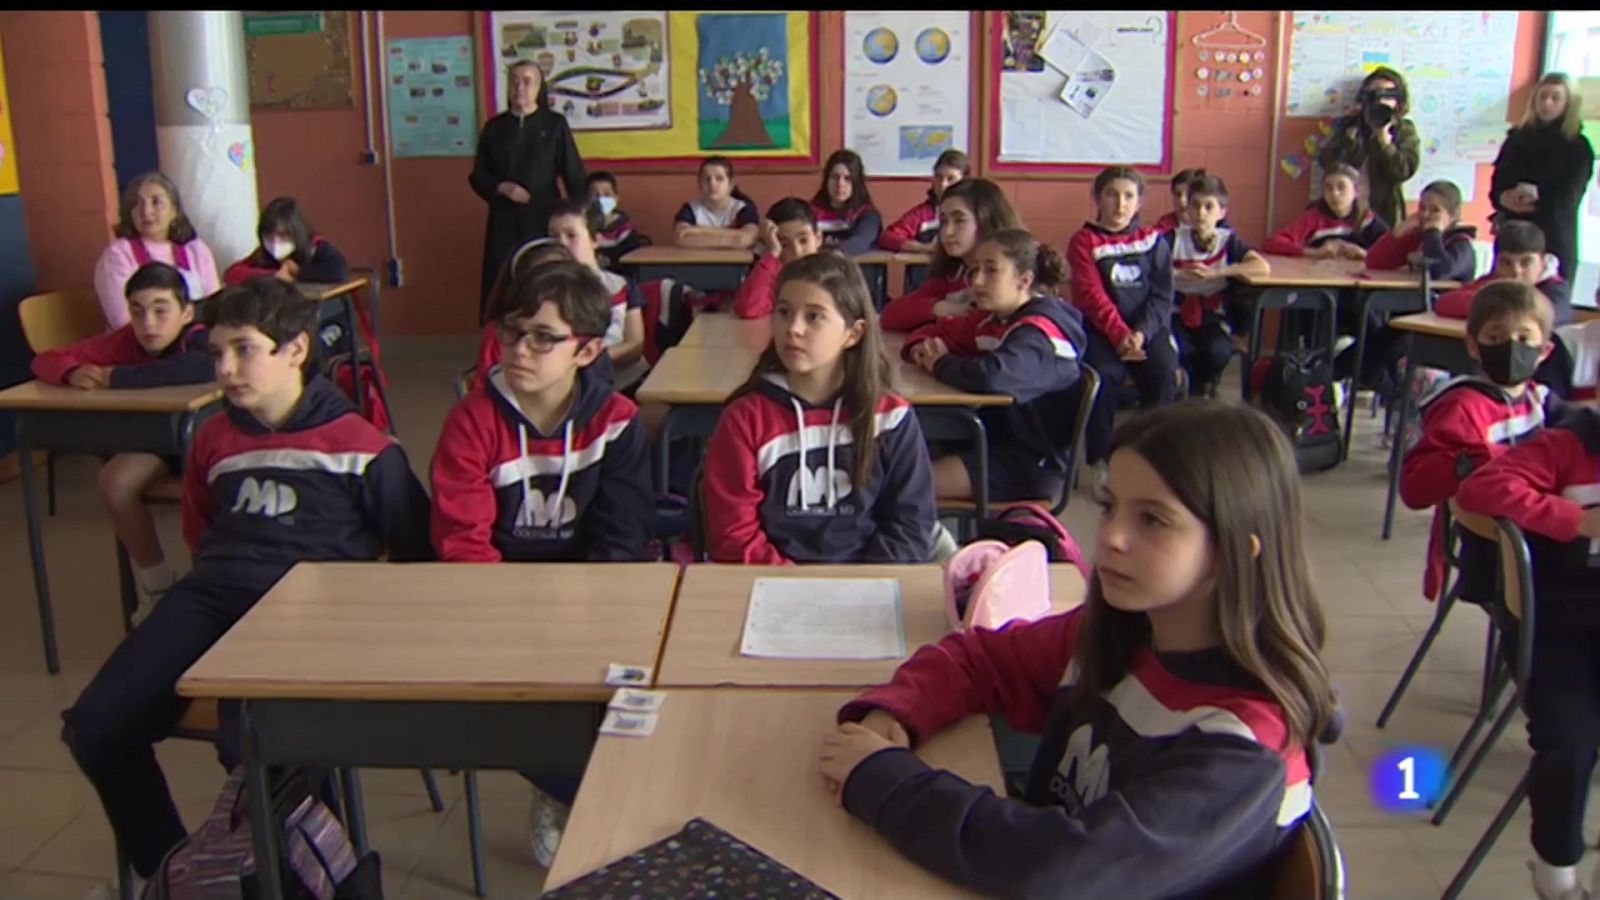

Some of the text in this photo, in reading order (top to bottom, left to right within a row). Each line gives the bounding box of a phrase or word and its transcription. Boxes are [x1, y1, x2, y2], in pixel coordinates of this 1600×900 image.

[231, 476, 298, 517] MD
[786, 465, 853, 507] MD
[514, 488, 577, 528] MD
